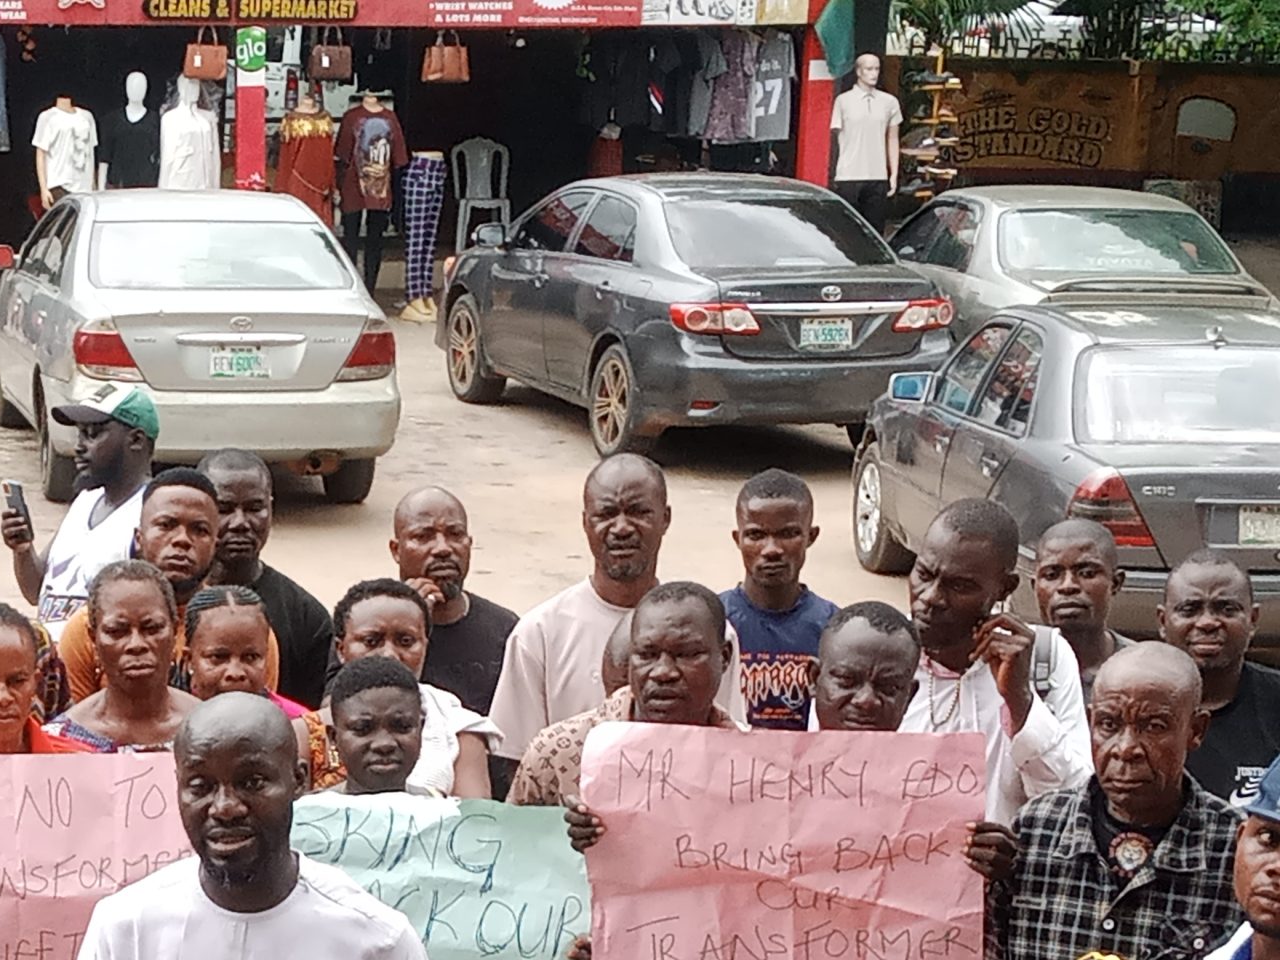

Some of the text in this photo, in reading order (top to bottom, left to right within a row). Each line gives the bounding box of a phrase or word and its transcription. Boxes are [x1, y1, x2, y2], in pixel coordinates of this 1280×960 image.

[149, 0, 356, 19] CLEANS & SUPERMARKET
[236, 38, 267, 66] glo
[958, 104, 1110, 140] THE GOLD
[953, 132, 1104, 167] STANDARD
[620, 748, 691, 812] MR
[729, 756, 869, 805] HENRY
[15, 777, 73, 833] NO
[114, 767, 168, 828] TO
[674, 831, 951, 875] BRING BACK
[756, 879, 858, 912] OUR
